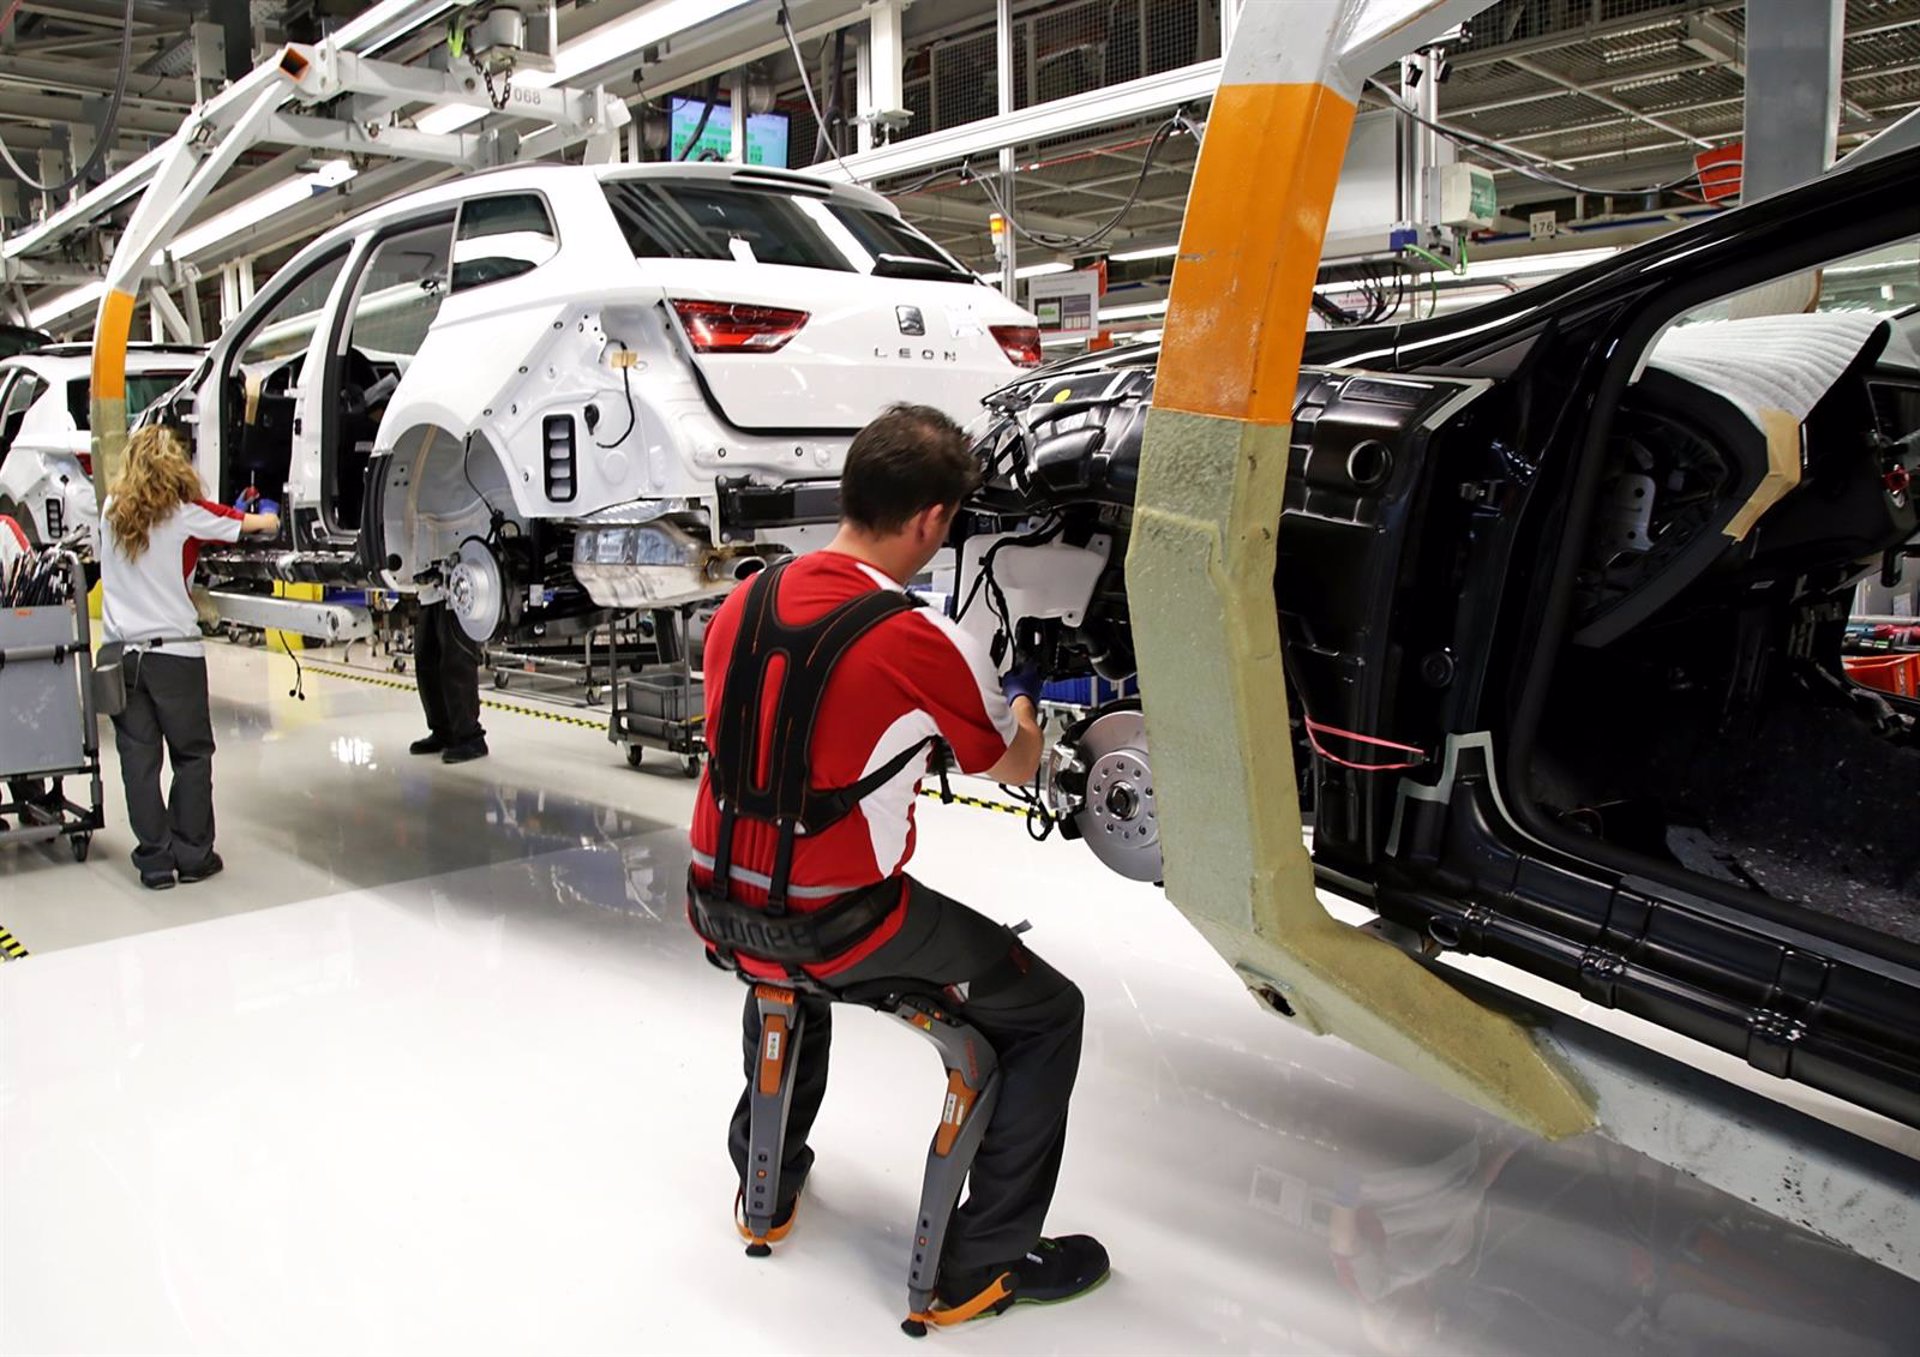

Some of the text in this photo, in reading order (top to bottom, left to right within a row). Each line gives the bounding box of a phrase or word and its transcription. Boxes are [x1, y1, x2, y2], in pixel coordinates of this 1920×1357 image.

[514, 87, 541, 105] 068
[1533, 221, 1554, 232] 176
[874, 347, 957, 362] LEON
